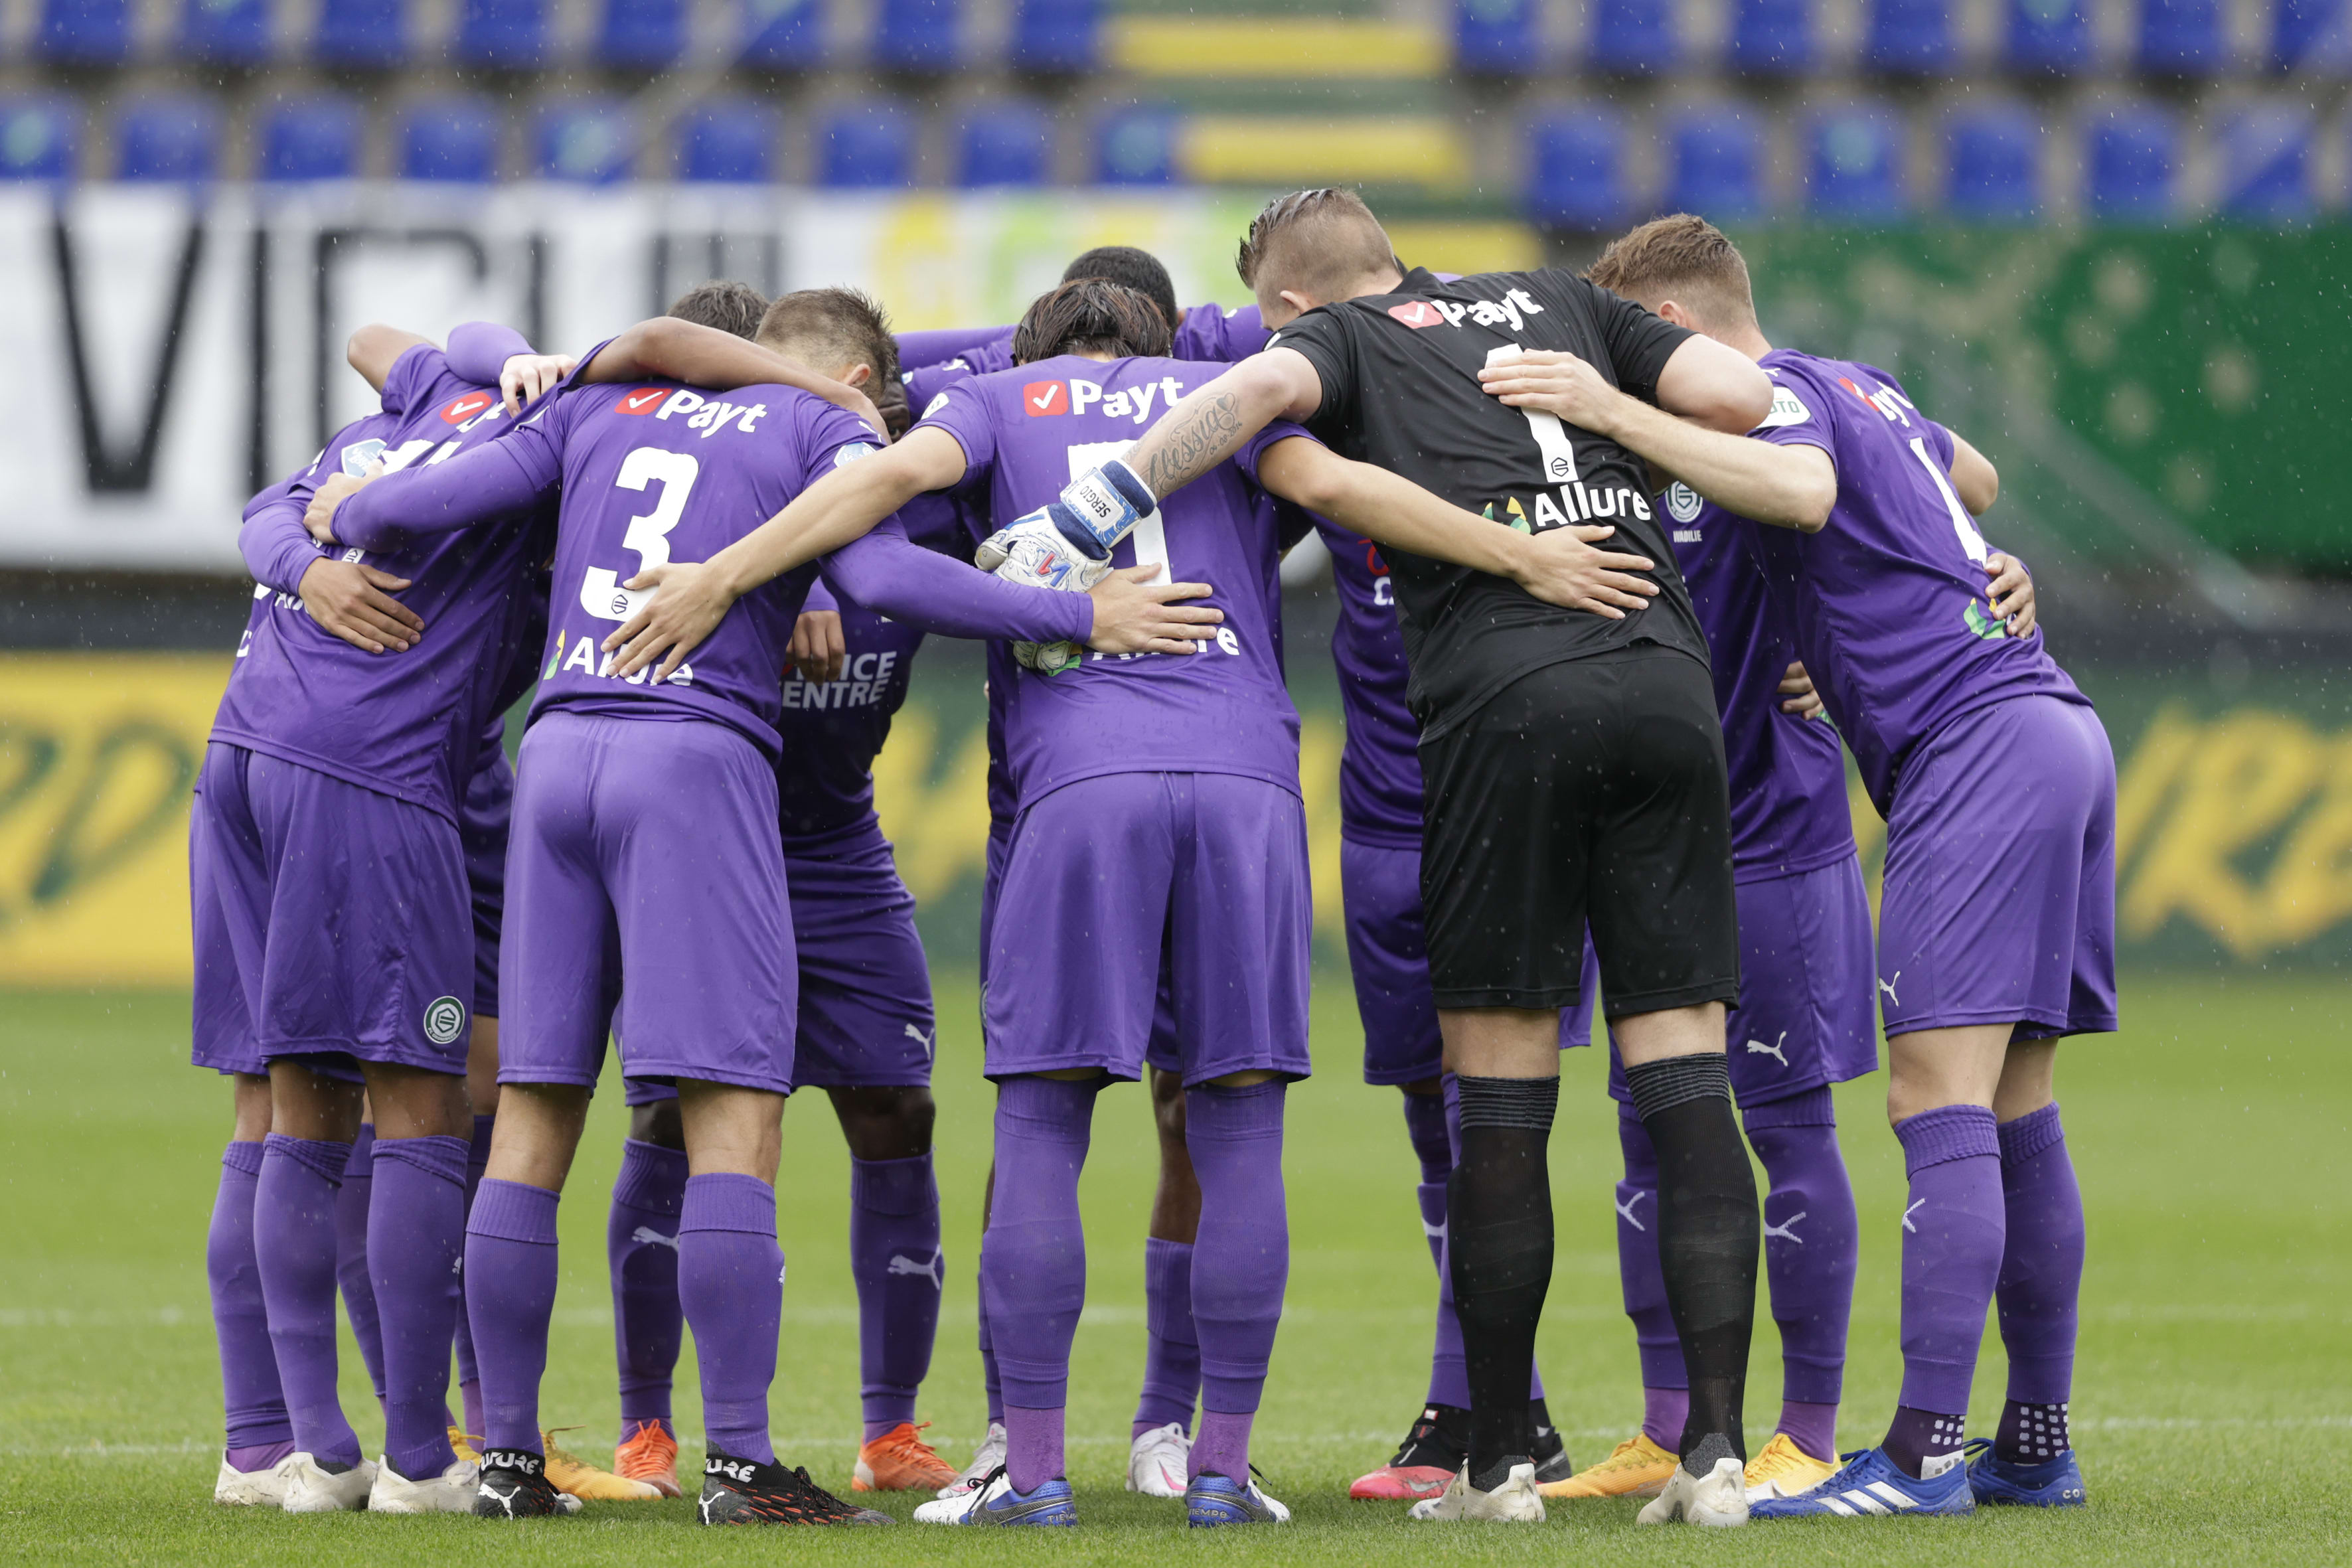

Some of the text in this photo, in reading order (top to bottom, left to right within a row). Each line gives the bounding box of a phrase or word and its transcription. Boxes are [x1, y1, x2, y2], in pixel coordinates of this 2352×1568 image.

[1430, 288, 1544, 331] Payt
[655, 389, 767, 439] Payt
[1069, 376, 1184, 425] Payt
[1484, 343, 1579, 483] 1
[1080, 486, 1111, 518] SERGIO
[1535, 481, 1651, 527] Allure
[580, 446, 699, 621] 3
[779, 678, 890, 709] ENTRE
[479, 1452, 540, 1475] UTURE
[706, 1458, 756, 1483] URE
